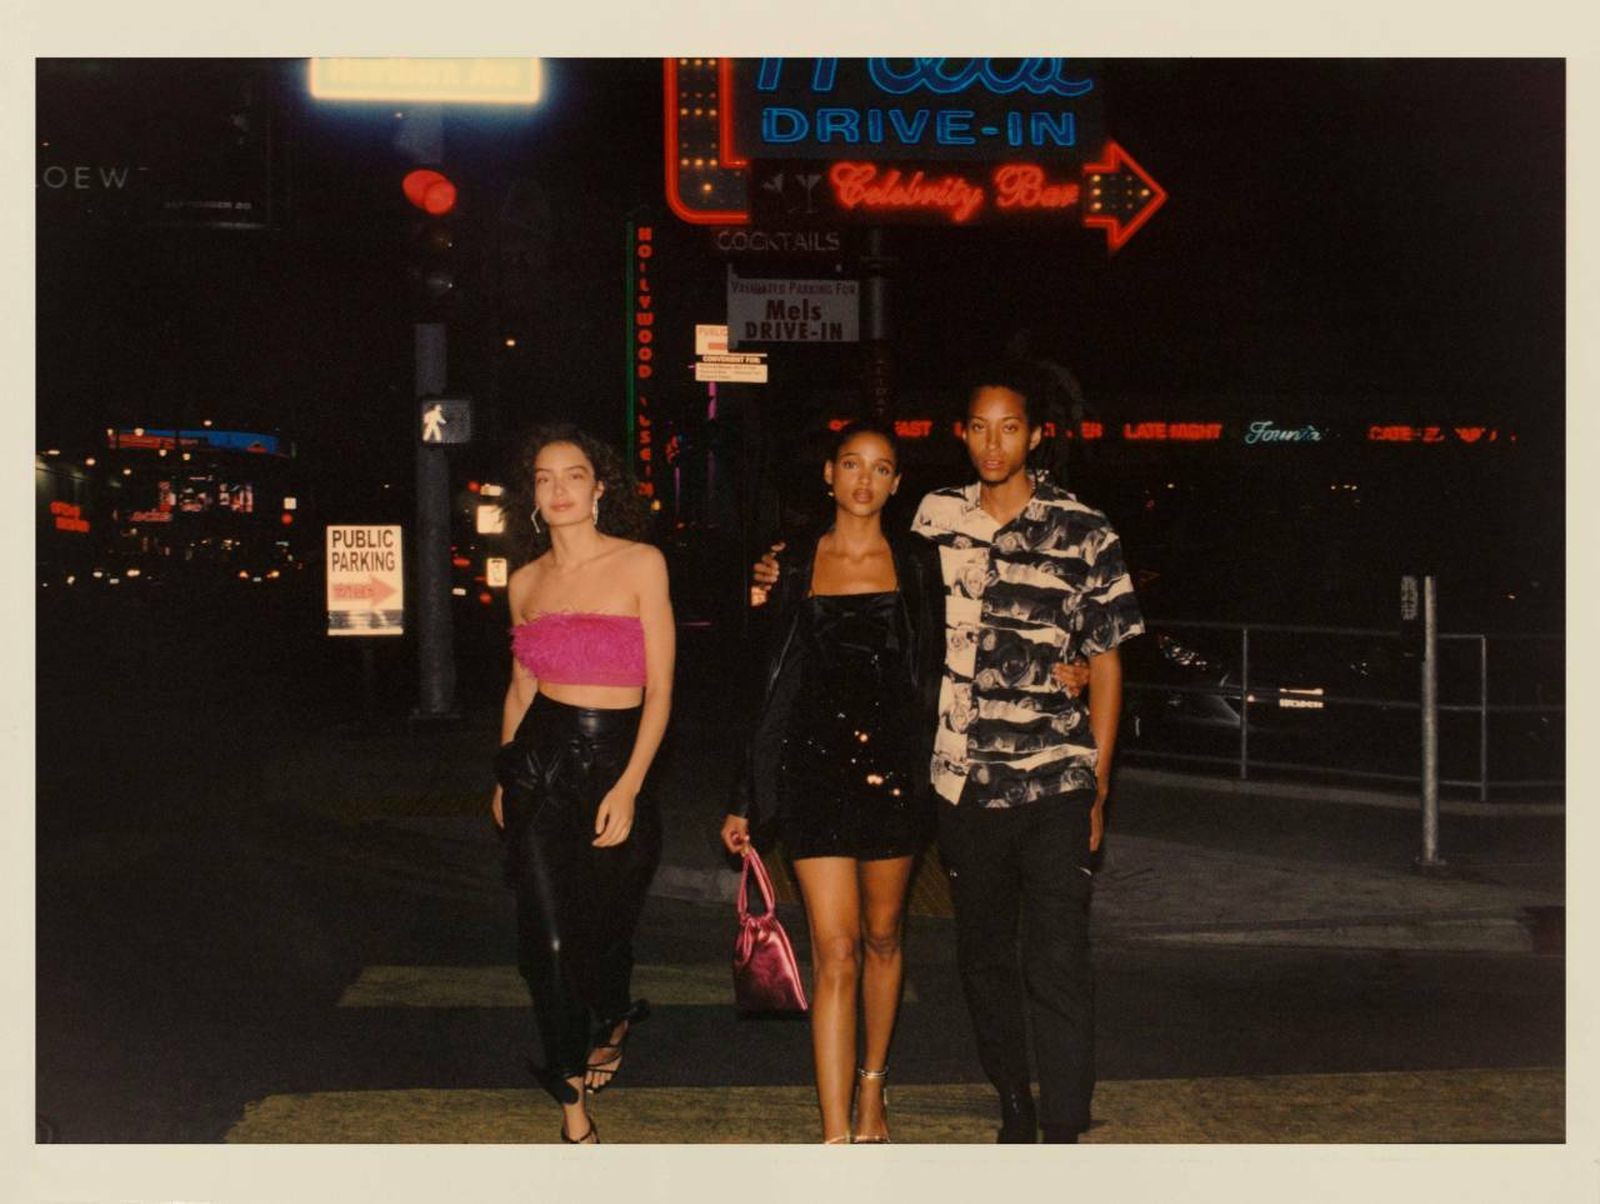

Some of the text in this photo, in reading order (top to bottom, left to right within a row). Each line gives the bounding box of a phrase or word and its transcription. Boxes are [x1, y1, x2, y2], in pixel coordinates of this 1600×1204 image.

[761, 107, 1077, 146] DRIVE-IN
[36, 165, 149, 189] OEW
[829, 162, 1079, 222] Celebrity Bar
[717, 229, 841, 252] COCKTAILS
[789, 281, 833, 296] PARKING
[766, 298, 822, 321] Mels
[745, 321, 843, 341] DRIVE-IN
[1124, 422, 1223, 440] LATE NIGHT
[332, 529, 394, 548] PUBLIC
[332, 551, 396, 572] PARKING
